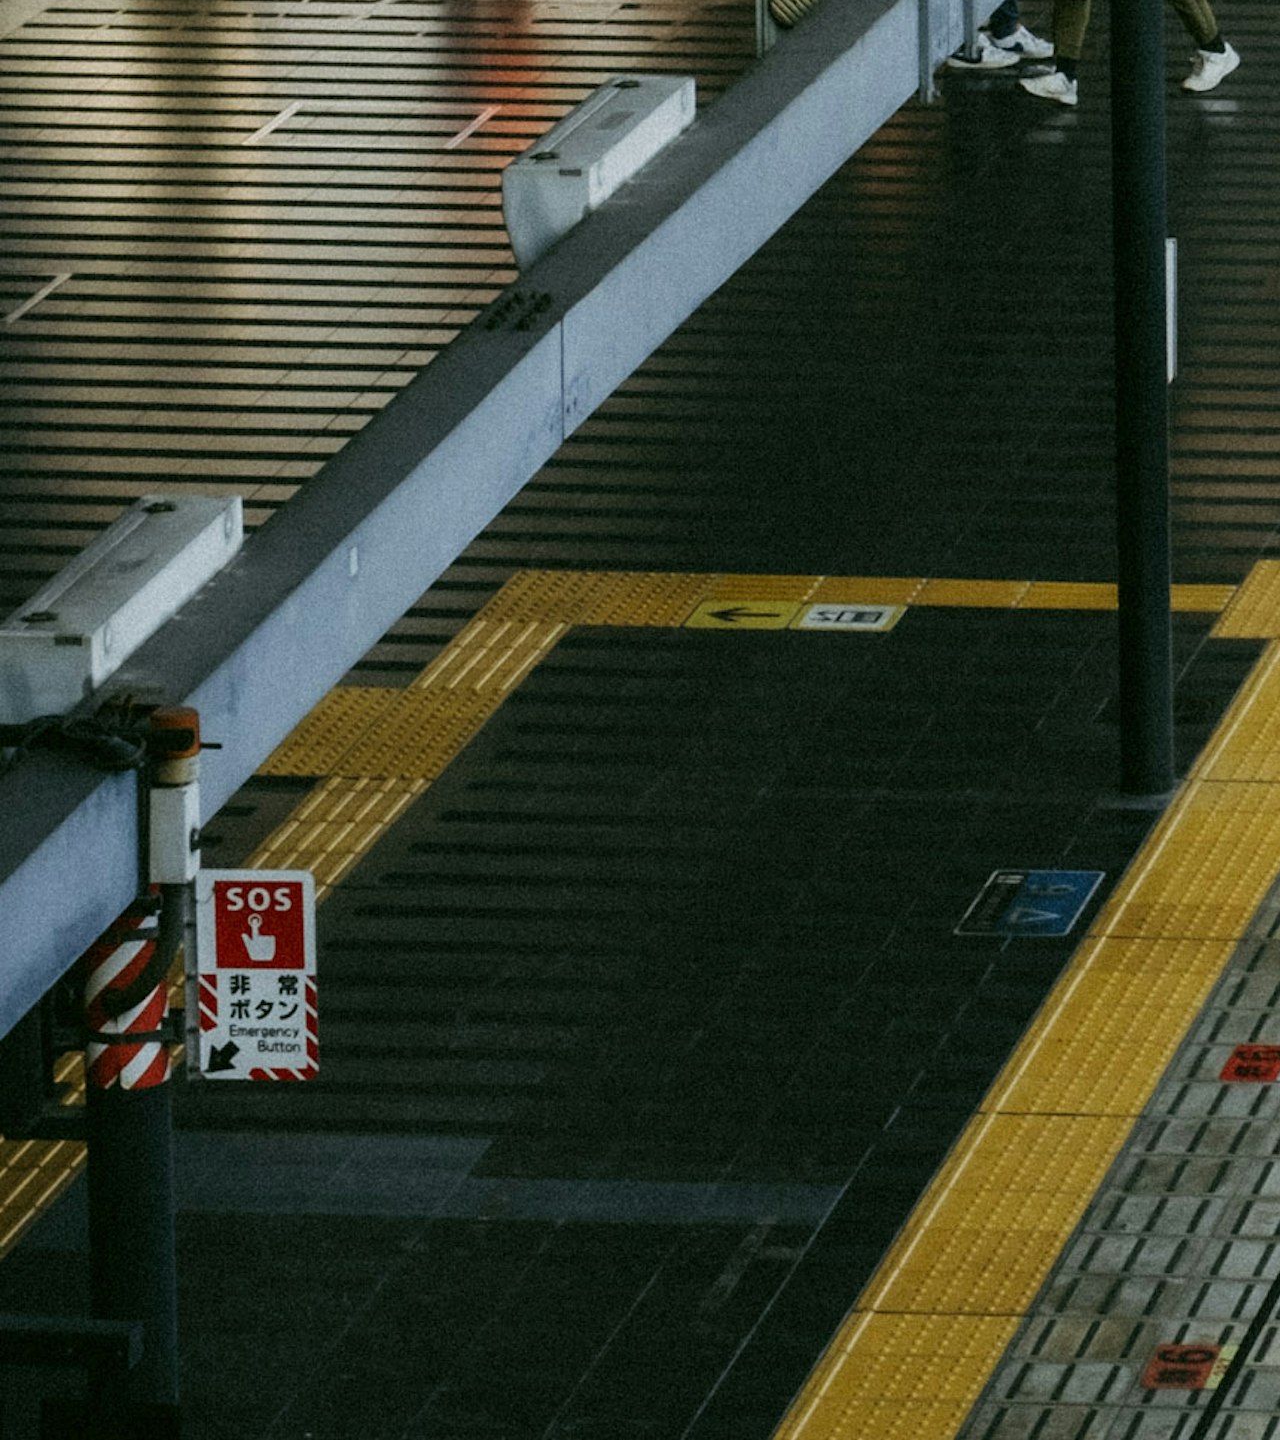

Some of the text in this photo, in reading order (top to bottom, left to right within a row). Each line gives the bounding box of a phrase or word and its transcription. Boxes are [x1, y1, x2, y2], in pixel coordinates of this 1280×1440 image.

[226, 887, 292, 911] SOS
[230, 999, 299, 1020] ボタン
[229, 1024, 300, 1039] Emergency
[257, 1040, 301, 1054] Button
